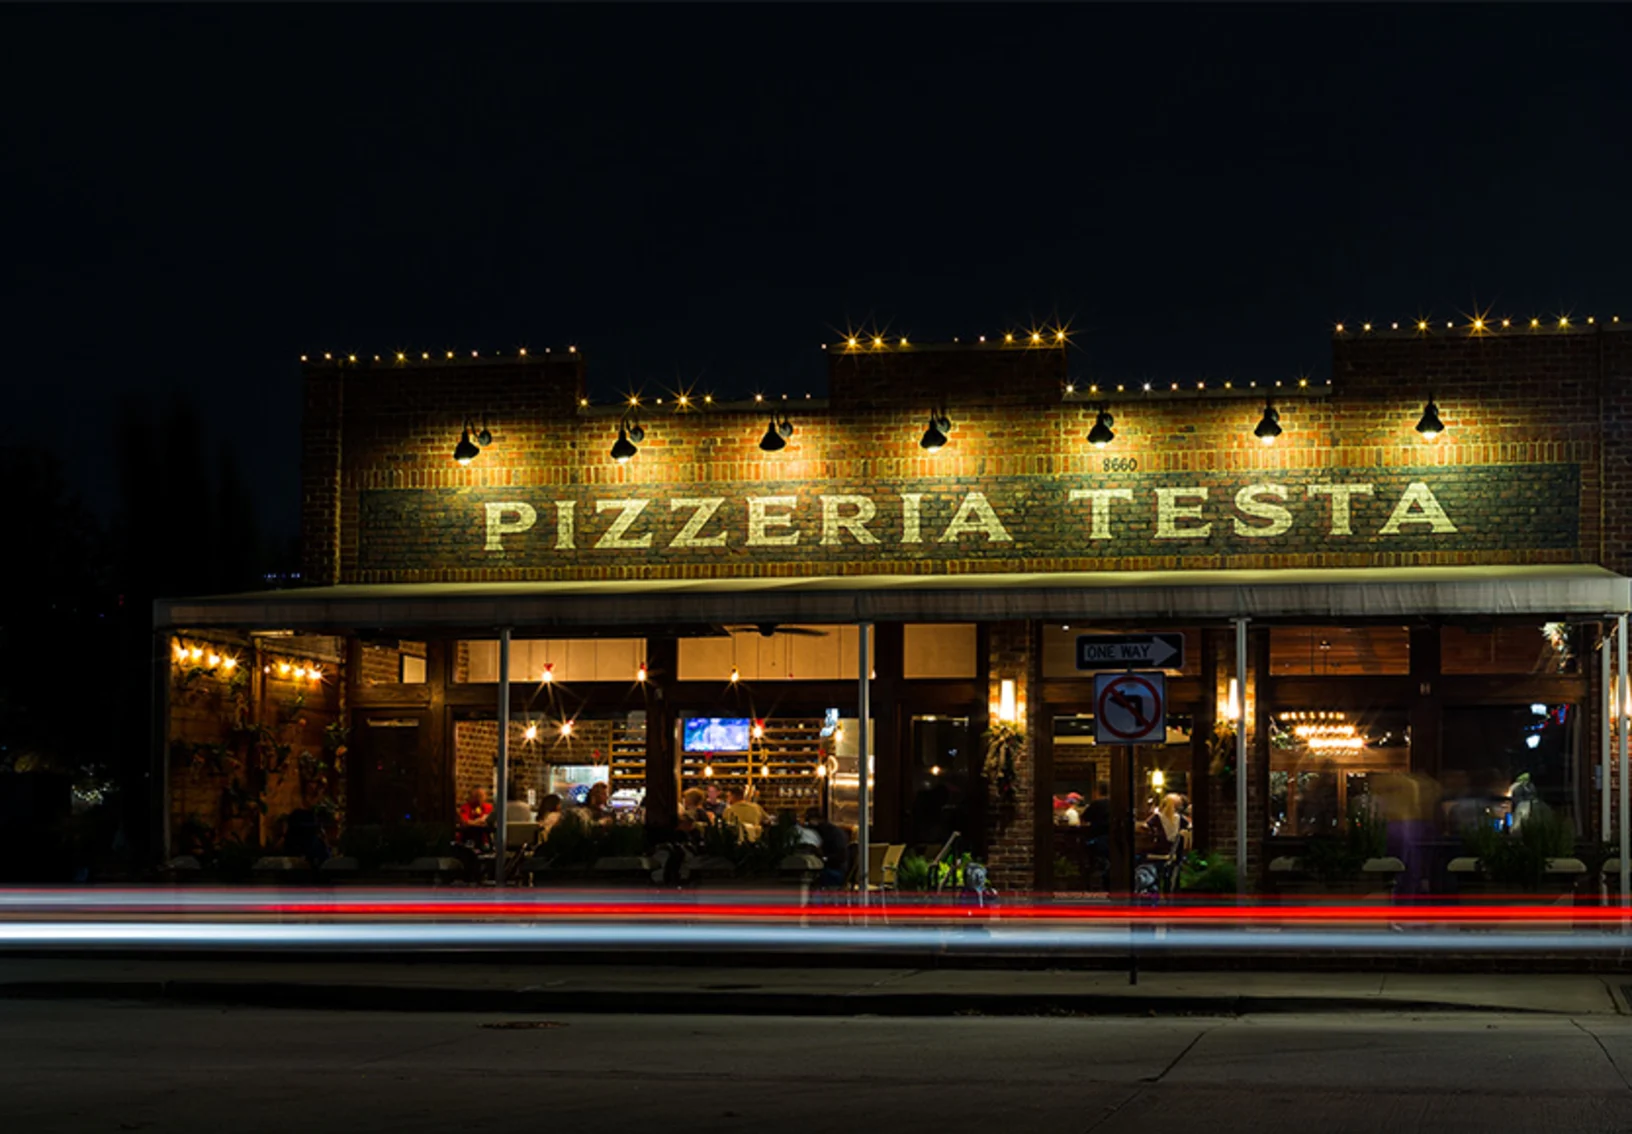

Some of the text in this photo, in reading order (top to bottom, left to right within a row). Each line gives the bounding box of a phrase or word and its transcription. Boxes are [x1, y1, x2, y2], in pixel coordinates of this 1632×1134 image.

[1103, 457, 1138, 472] 8660
[483, 482, 1458, 552] PIZZERIA TESTA
[1087, 645, 1150, 659] ONE WAY
